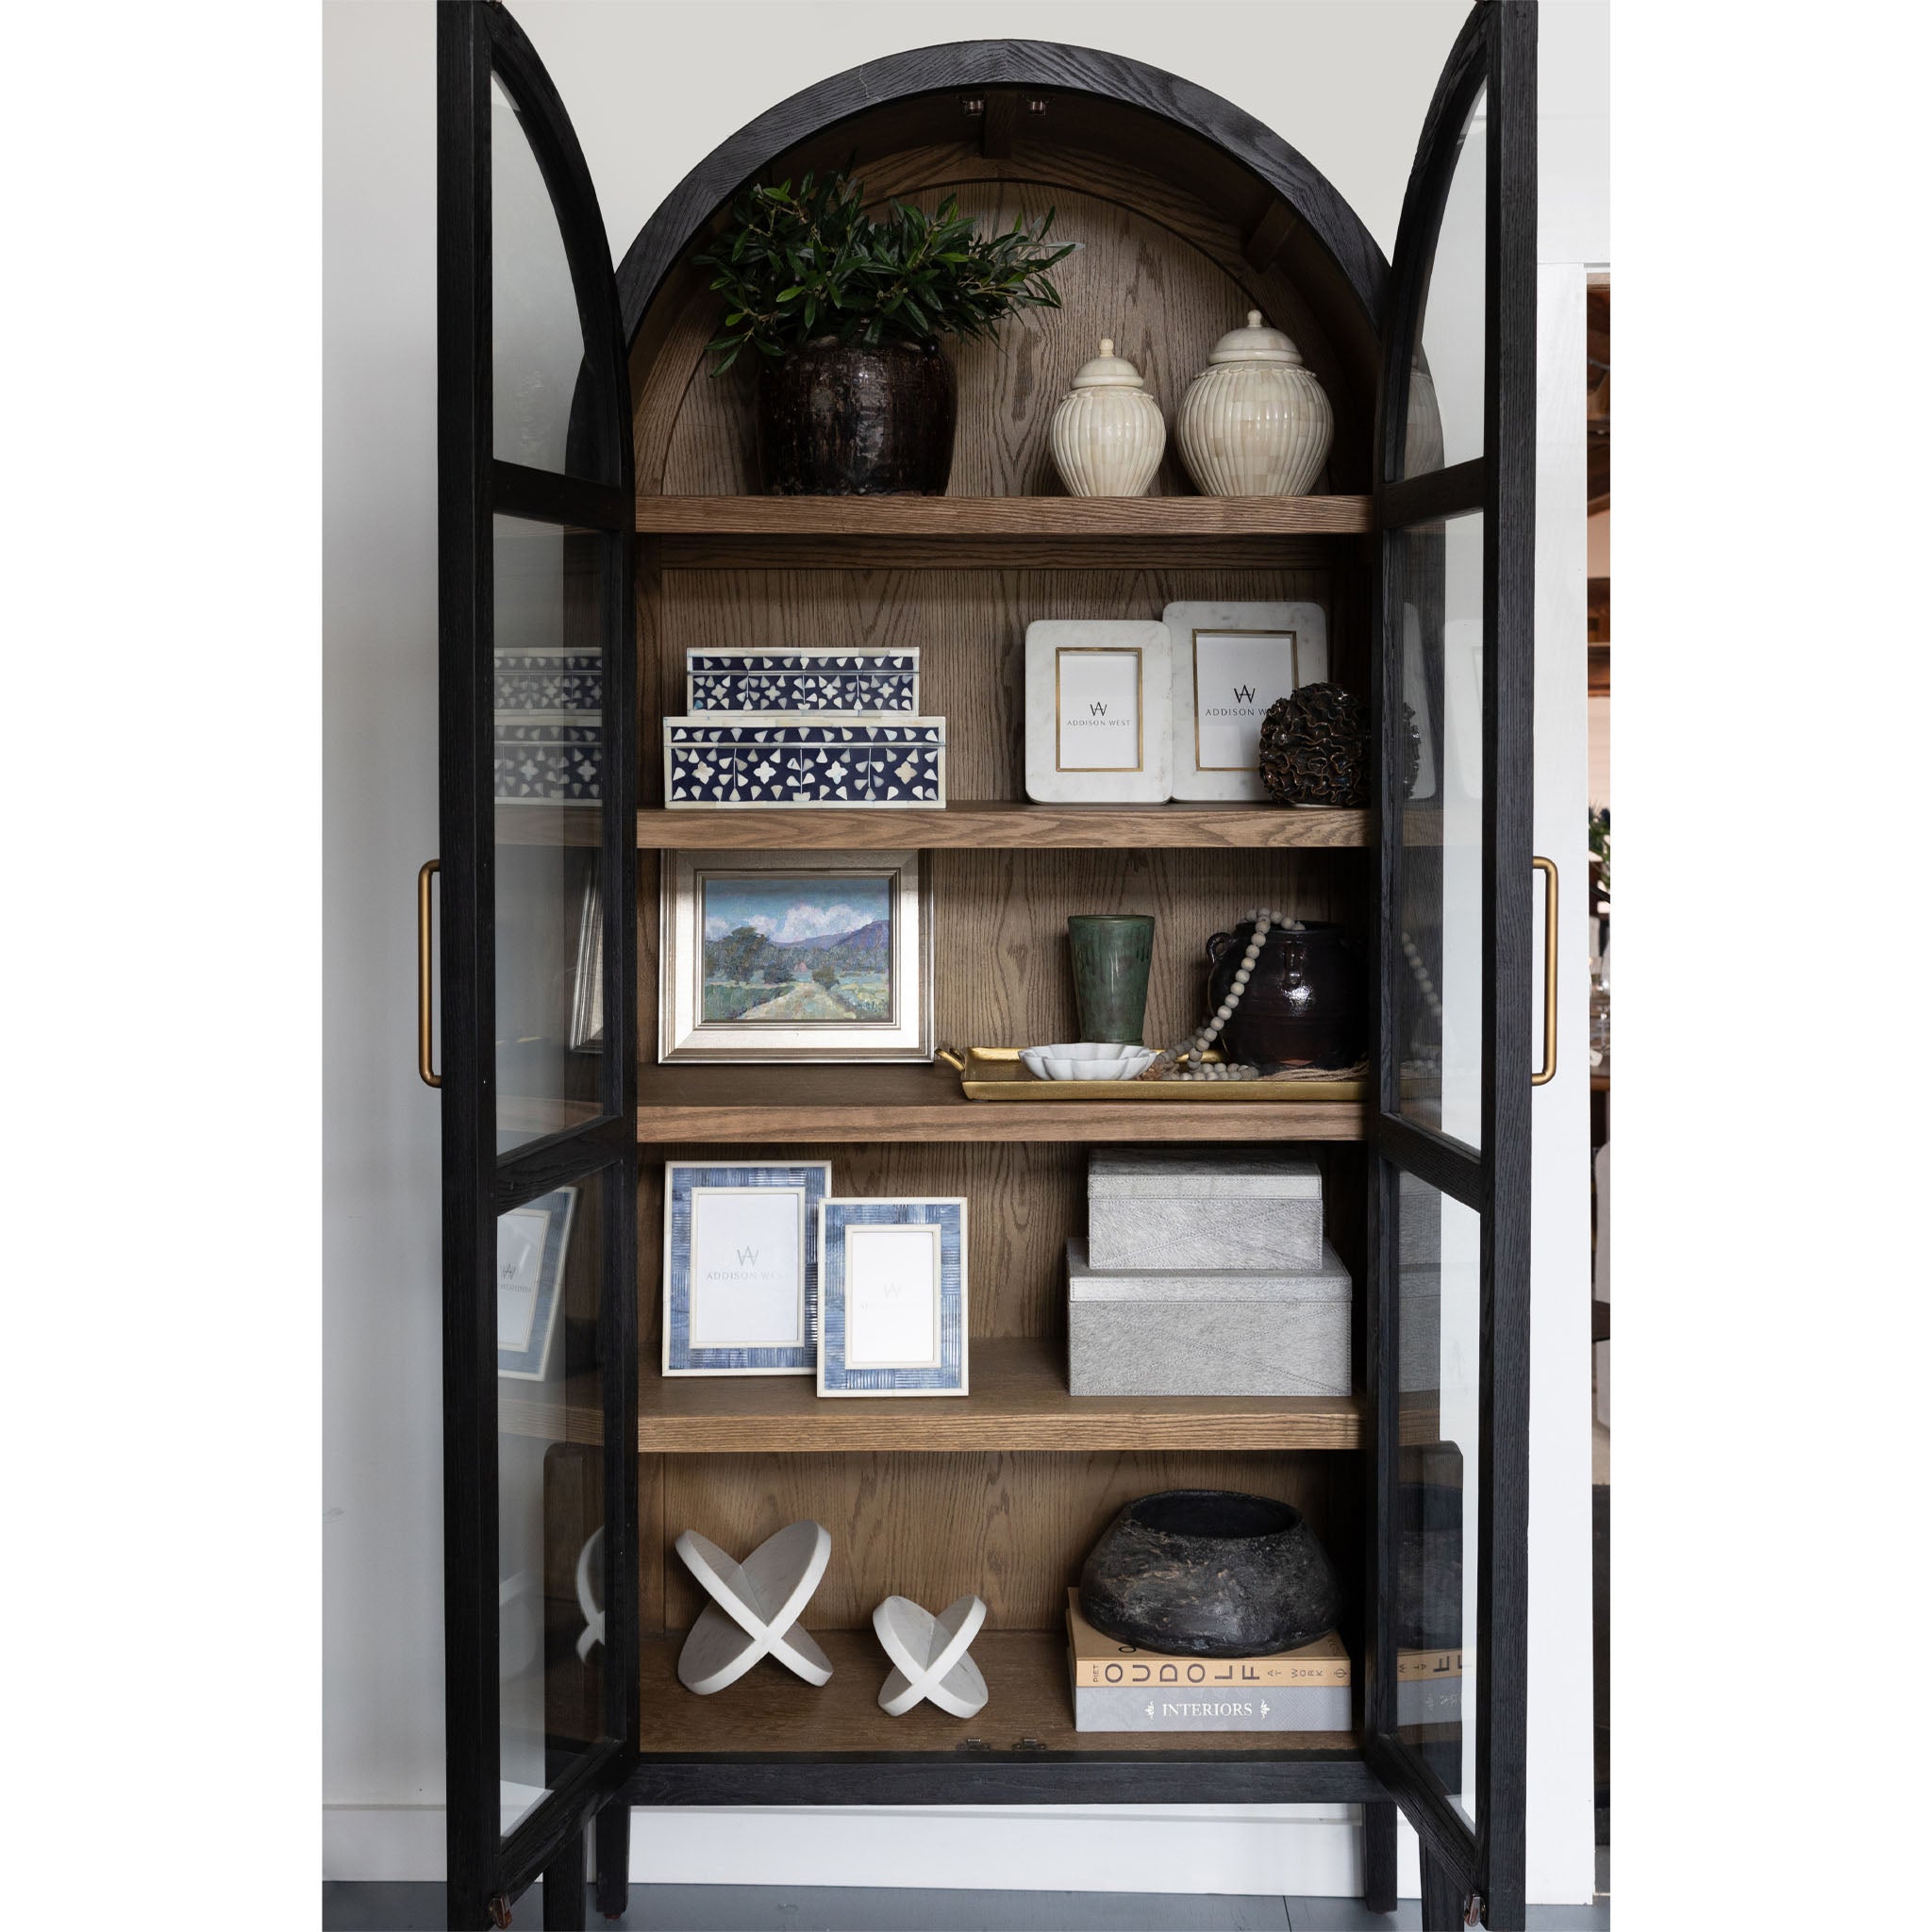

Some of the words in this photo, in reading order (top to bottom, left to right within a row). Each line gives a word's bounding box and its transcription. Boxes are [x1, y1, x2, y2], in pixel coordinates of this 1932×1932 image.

[706, 1272, 757, 1280] ADDISON
[1105, 1663, 1260, 1684] OUDOLF
[1291, 1668, 1323, 1678] WORK
[1161, 1703, 1253, 1717] INTERIORS
